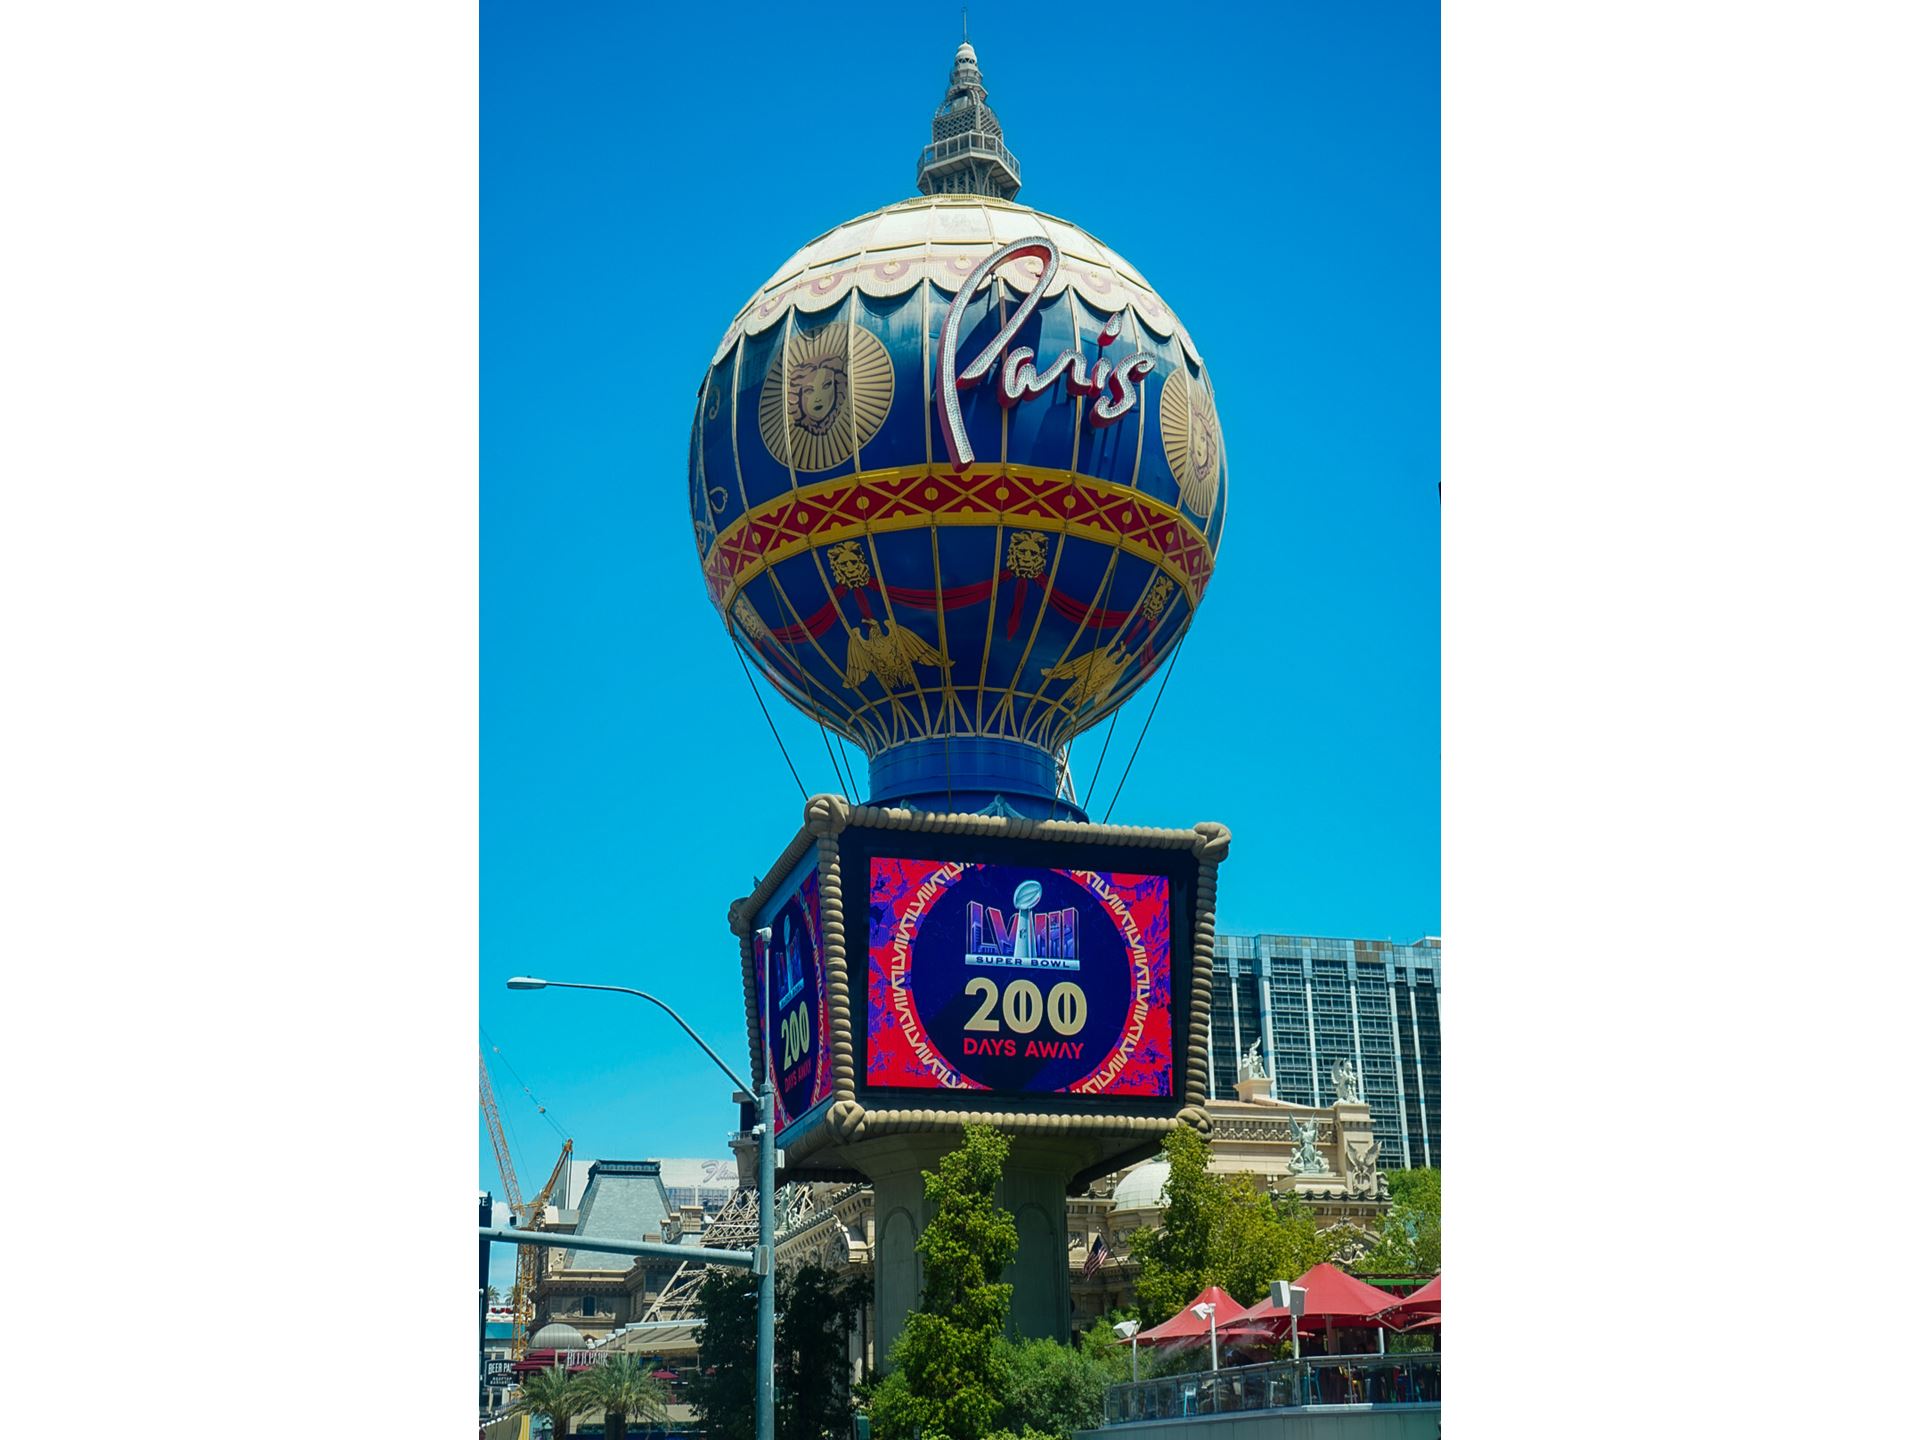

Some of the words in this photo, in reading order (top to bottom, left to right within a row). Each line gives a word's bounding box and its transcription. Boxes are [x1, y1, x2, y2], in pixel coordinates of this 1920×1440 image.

[937, 236, 1156, 473] Paris
[976, 956, 1022, 966] SUPER
[1030, 959, 1070, 969] BOWL
[964, 977, 1087, 1035] 200
[781, 1001, 810, 1071] 200
[963, 1038, 1017, 1057] DAYS
[1025, 1041, 1084, 1059] AWAY
[488, 1363, 502, 1375] BEER
